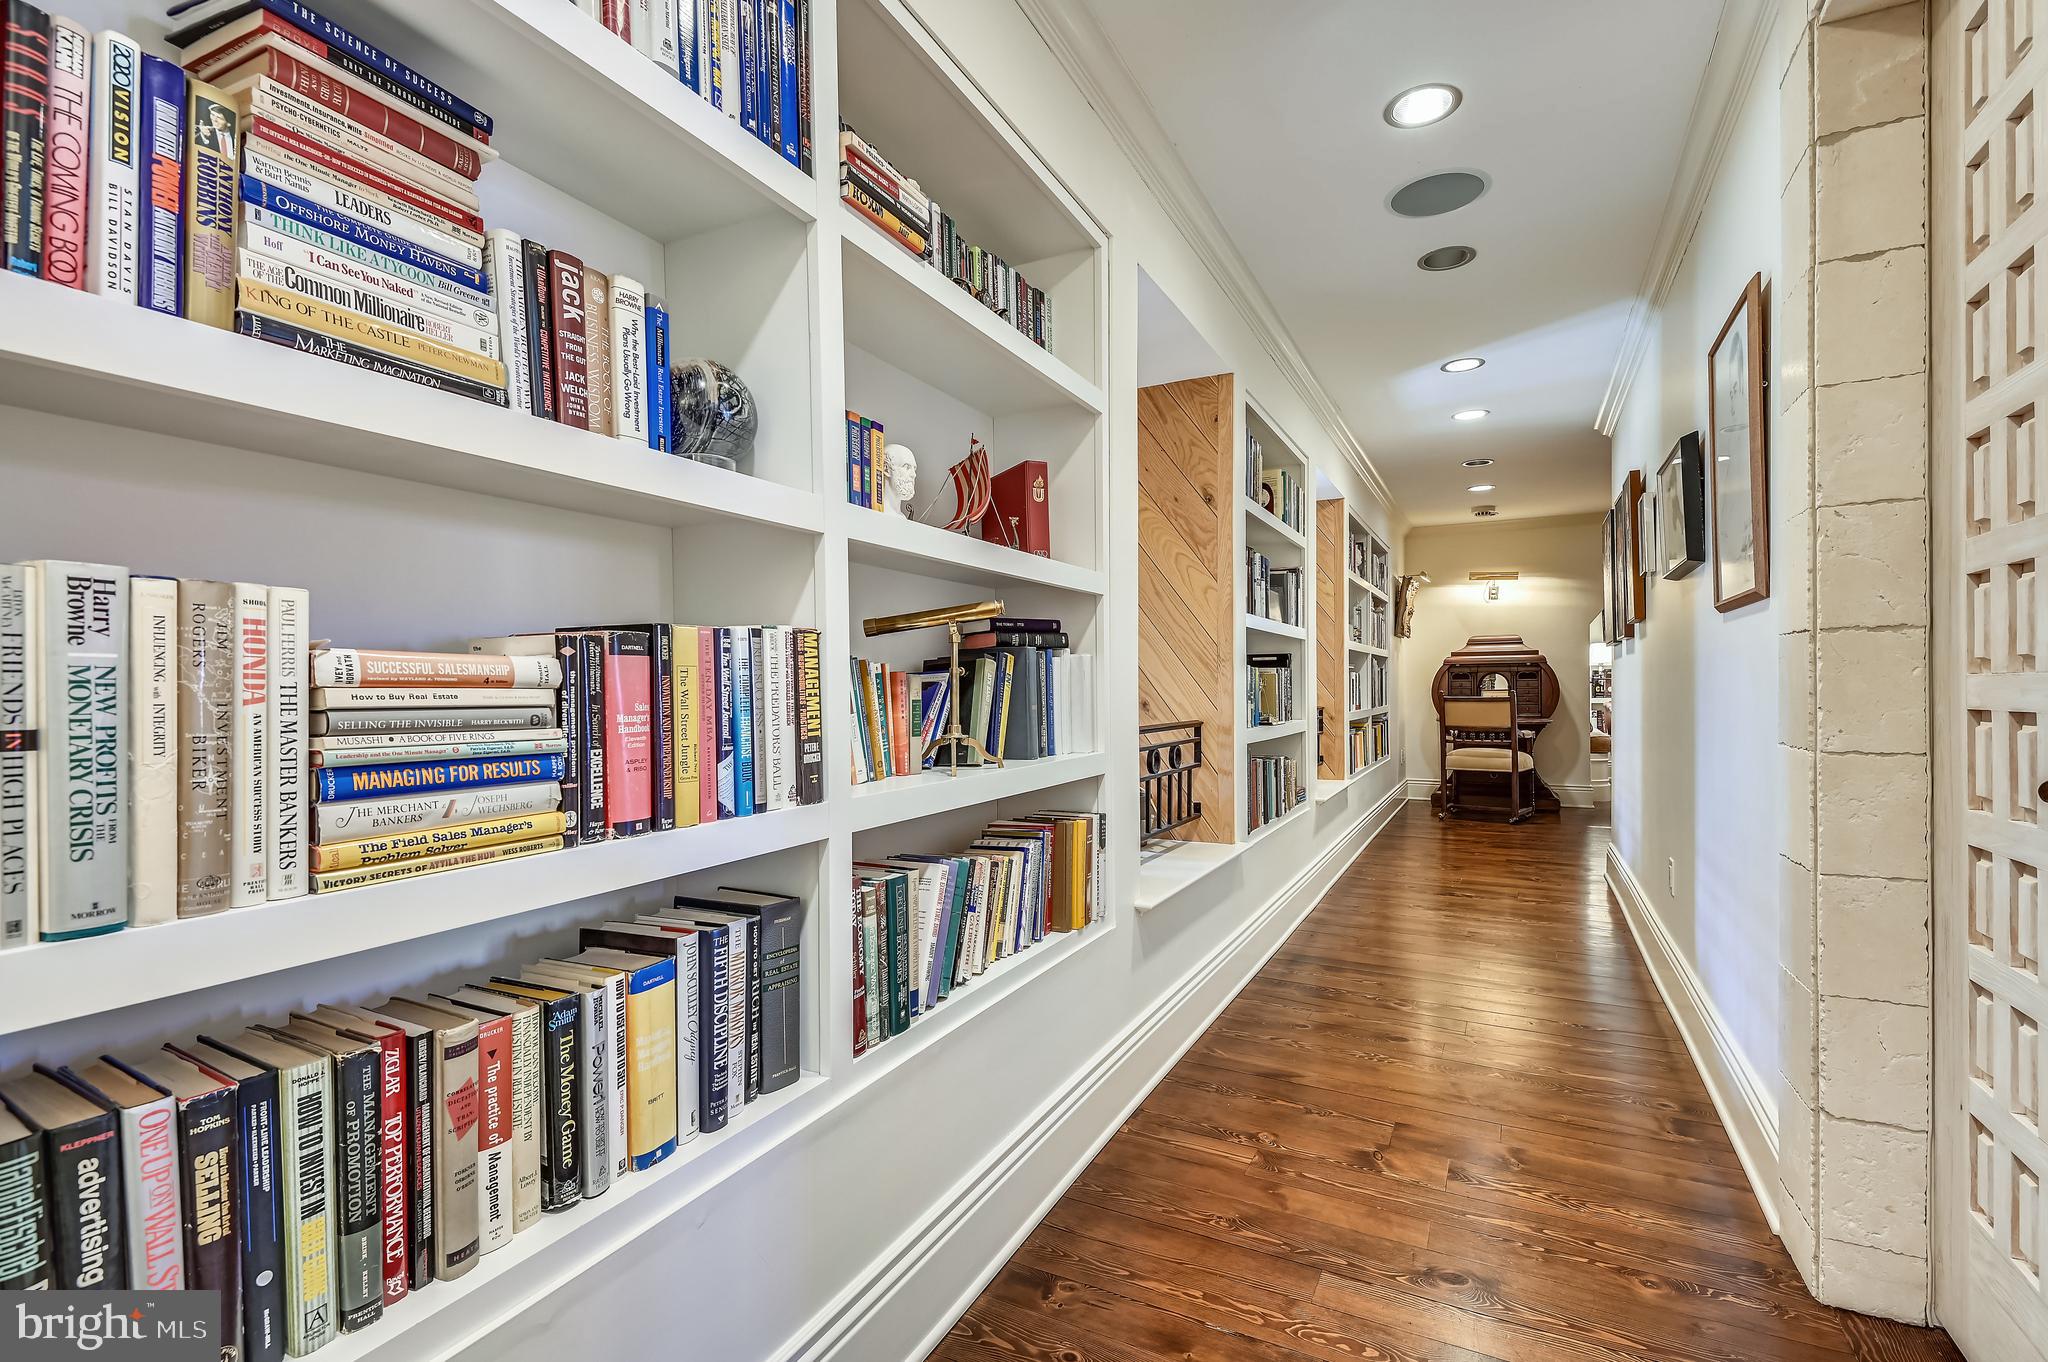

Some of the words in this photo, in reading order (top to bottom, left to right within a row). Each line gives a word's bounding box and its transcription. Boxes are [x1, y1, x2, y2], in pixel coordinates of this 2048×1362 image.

[293, 1, 316, 25] THE
[325, 22, 377, 60] SCIENCE
[384, 58, 398, 72] OF
[405, 70, 452, 106] SUCCESS
[54, 86, 83, 130] THE
[114, 89, 130, 162] VISION
[50, 132, 81, 234] COMING
[252, 156, 284, 174] Warren
[284, 169, 312, 187] Bennis
[255, 165, 264, 174] &
[264, 167, 283, 183] Burt
[284, 179, 310, 193] Nanus
[108, 183, 118, 211] BILL
[196, 151, 218, 230] ROBBINS
[218, 159, 234, 237] ANTHONY
[124, 189, 132, 232] STAN
[335, 189, 392, 226] LEADERS
[264, 236, 283, 251] Hoff
[270, 213, 325, 249] THINK
[326, 236, 367, 262] LIKE
[370, 251, 382, 266] A
[380, 255, 436, 289] TYCOON
[275, 195, 350, 234] OFFSHORE
[354, 227, 407, 256] MONEY
[410, 249, 457, 276] HAVENS
[107, 219, 117, 290] DAVIDSON
[123, 243, 132, 294] DAVIS
[246, 258, 266, 269] THE
[267, 266, 284, 277] AGE
[317, 254, 340, 273] Can
[342, 263, 361, 279] See
[360, 269, 380, 287] You
[284, 266, 351, 308] Common
[354, 288, 425, 332] Millionaire
[438, 280, 452, 292] Bill
[453, 285, 480, 303] Greene
[615, 298, 642, 312] BROWNE
[618, 290, 640, 303] HARRY
[246, 286, 292, 310] KING
[296, 302, 316, 317] OF
[321, 309, 354, 330] THE
[357, 321, 411, 348] CASTLE
[418, 343, 444, 357] PETER
[451, 353, 490, 371] NEWMAN
[622, 327, 630, 346] Plans
[294, 333, 370, 369] MARKETING
[372, 361, 441, 389] IMAGINATION
[561, 352, 575, 362] THE
[575, 356, 587, 366] GUT
[565, 343, 583, 353] FROM
[621, 349, 630, 377] Usually
[561, 383, 588, 398] WELCH
[564, 371, 585, 384] JACK
[623, 379, 631, 390] Go
[623, 390, 631, 419] Wrong
[67, 575, 93, 646] Browne
[88, 578, 116, 637] Harry
[281, 599, 295, 630] PAUL
[153, 615, 166, 683] INFLUENCING
[192, 602, 206, 668] ROGERS
[242, 618, 266, 707] HONDA
[281, 633, 295, 678] FERRIS
[367, 660, 435, 675] SUCCESSFUL
[438, 663, 510, 676] SALESMANSHIP
[94, 665, 117, 716] NEW
[153, 687, 161, 698] with
[680, 667, 689, 686] The
[805, 632, 821, 738] MANAGEMENT
[279, 681, 298, 717] THE
[351, 693, 374, 701] How
[388, 693, 405, 702] Buy
[433, 692, 459, 700] Estate
[680, 688, 689, 713] Wall
[67, 665, 93, 784] MONETARY
[153, 703, 166, 758] INTEGRITY
[680, 714, 689, 743] Street
[192, 735, 207, 791] BIKER
[279, 719, 298, 788] MASTER
[679, 745, 689, 775] Jungle
[95, 725, 117, 816] PROFITS
[352, 766, 445, 791] MANAGING
[449, 764, 479, 783] FOR
[483, 759, 541, 780] RESULTS
[590, 749, 604, 810] EXCELLENCE
[772, 757, 782, 790] BALL
[335, 806, 373, 829] THE
[376, 801, 439, 816] MERCHANT
[372, 813, 423, 828] BANKERS
[463, 793, 508, 817] JOSEPH
[478, 801, 533, 815] WECHSBERG
[69, 788, 95, 862] CRISIS
[108, 818, 117, 844] FROM
[279, 790, 297, 870] BANKERS
[359, 842, 388, 853] The
[391, 835, 428, 848] Field
[432, 830, 467, 843] Sales
[470, 820, 533, 837] Manager's
[360, 850, 421, 866] Problem
[424, 842, 468, 856] Solver
[684, 941, 697, 970] JOHN
[713, 934, 729, 947] THE
[766, 946, 798, 961] ENCYCLOPEDIA
[713, 946, 729, 990] FIFTH
[764, 969, 780, 978] REAL
[780, 963, 798, 974] ESTATE
[767, 977, 798, 991] APPRAISING
[687, 971, 697, 1020] SCULLEY
[559, 1029, 574, 1065] The
[684, 1020, 698, 1066] Odyssey
[713, 991, 729, 1070] DISCIPLINE
[298, 1078, 320, 1089] HOPPE
[362, 1065, 371, 1091] THE
[385, 1047, 400, 1098] ZIGLAR
[485, 1060, 500, 1082] The
[485, 1085, 502, 1129] practice
[558, 1062, 575, 1119] Money
[647, 1092, 664, 1106] BRITT
[199, 1114, 221, 1126] TOM
[297, 1090, 323, 1130] HOW
[346, 1101, 355, 1117] OF
[60, 1130, 115, 1152] KLEPPNER
[139, 1107, 172, 1158] ONE
[189, 1117, 231, 1136] HOPKINS
[298, 1126, 324, 1151] TO
[385, 1111, 402, 1141] TOP
[488, 1133, 503, 1145] of
[364, 1092, 377, 1217] MANAGEMENT
[560, 1120, 576, 1169] Game
[142, 1150, 173, 1182] UP
[299, 1148, 325, 1202] INVEST
[347, 1118, 362, 1224] PROMOTION
[150, 1183, 171, 1209] ON
[194, 1151, 222, 1247] SELLING
[385, 1143, 404, 1264] PERFORMANCE
[485, 1151, 502, 1223] Management
[76, 1157, 109, 1288] advertising
[300, 1197, 326, 1221] IN
[144, 1202, 177, 1270] WALL
[357, 1311, 375, 1324] HALL
